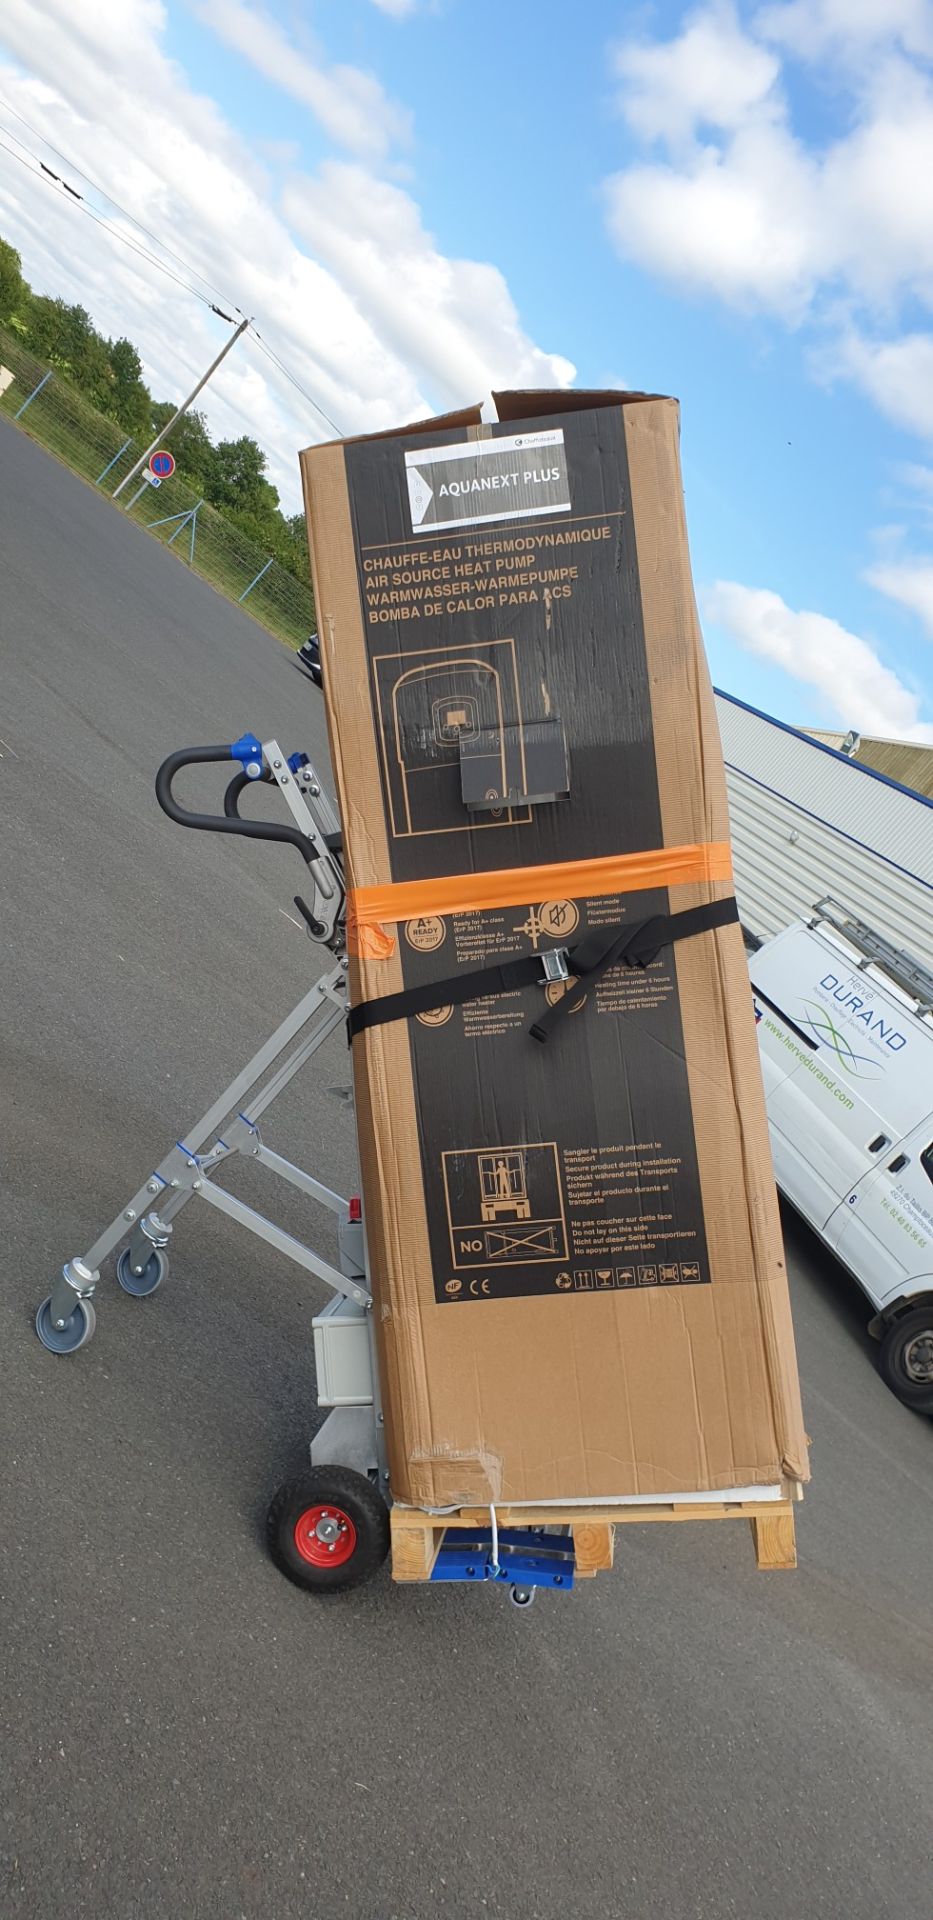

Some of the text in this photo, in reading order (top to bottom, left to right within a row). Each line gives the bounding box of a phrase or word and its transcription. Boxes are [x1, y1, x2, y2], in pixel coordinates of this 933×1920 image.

[439, 468, 560, 497] AQUANEXT PLUS
[363, 526, 612, 572] CHAUFFE-EAU THERMODYNAMIQUE
[365, 554, 536, 589] AIR SOURCE HEAT PUMP
[369, 585, 572, 624] BOMBA DE CALOR PARA ACS
[586, 899, 603, 907] Silent
[417, 918, 433, 928] A+
[412, 927, 438, 936] READY
[485, 947, 499, 955] para
[596, 1000, 618, 1008] Tiempo
[819, 974, 907, 1051] DURAND
[763, 1019, 855, 1110] www.hervedurand.com
[563, 1147, 590, 1157] Sangler
[599, 1145, 624, 1154] produit
[625, 1143, 653, 1152] pendant
[563, 1155, 596, 1164] transport
[565, 1157, 681, 1173] Secure product during installation
[566, 1167, 678, 1182] Produkt während des Transports
[567, 1191, 592, 1200] Sujetar
[593, 1189, 601, 1197] el
[601, 1187, 633, 1197] producto
[634, 1185, 661, 1193] durante
[568, 1197, 605, 1207] transporte
[848, 1194, 858, 1205] 6
[582, 1220, 595, 1228] pas
[596, 1217, 625, 1226] coucher
[638, 1214, 656, 1222] cette
[572, 1229, 583, 1237] Do
[583, 1228, 595, 1236] not
[596, 1227, 607, 1235] lay
[607, 1226, 618, 1234] on
[618, 1225, 632, 1233] this
[573, 1230, 697, 1246] Nicht auf dieser Seite transportieren
[460, 1240, 483, 1253] NO
[574, 1242, 656, 1255] No apoyar por este lado
[447, 1281, 461, 1291] NF
